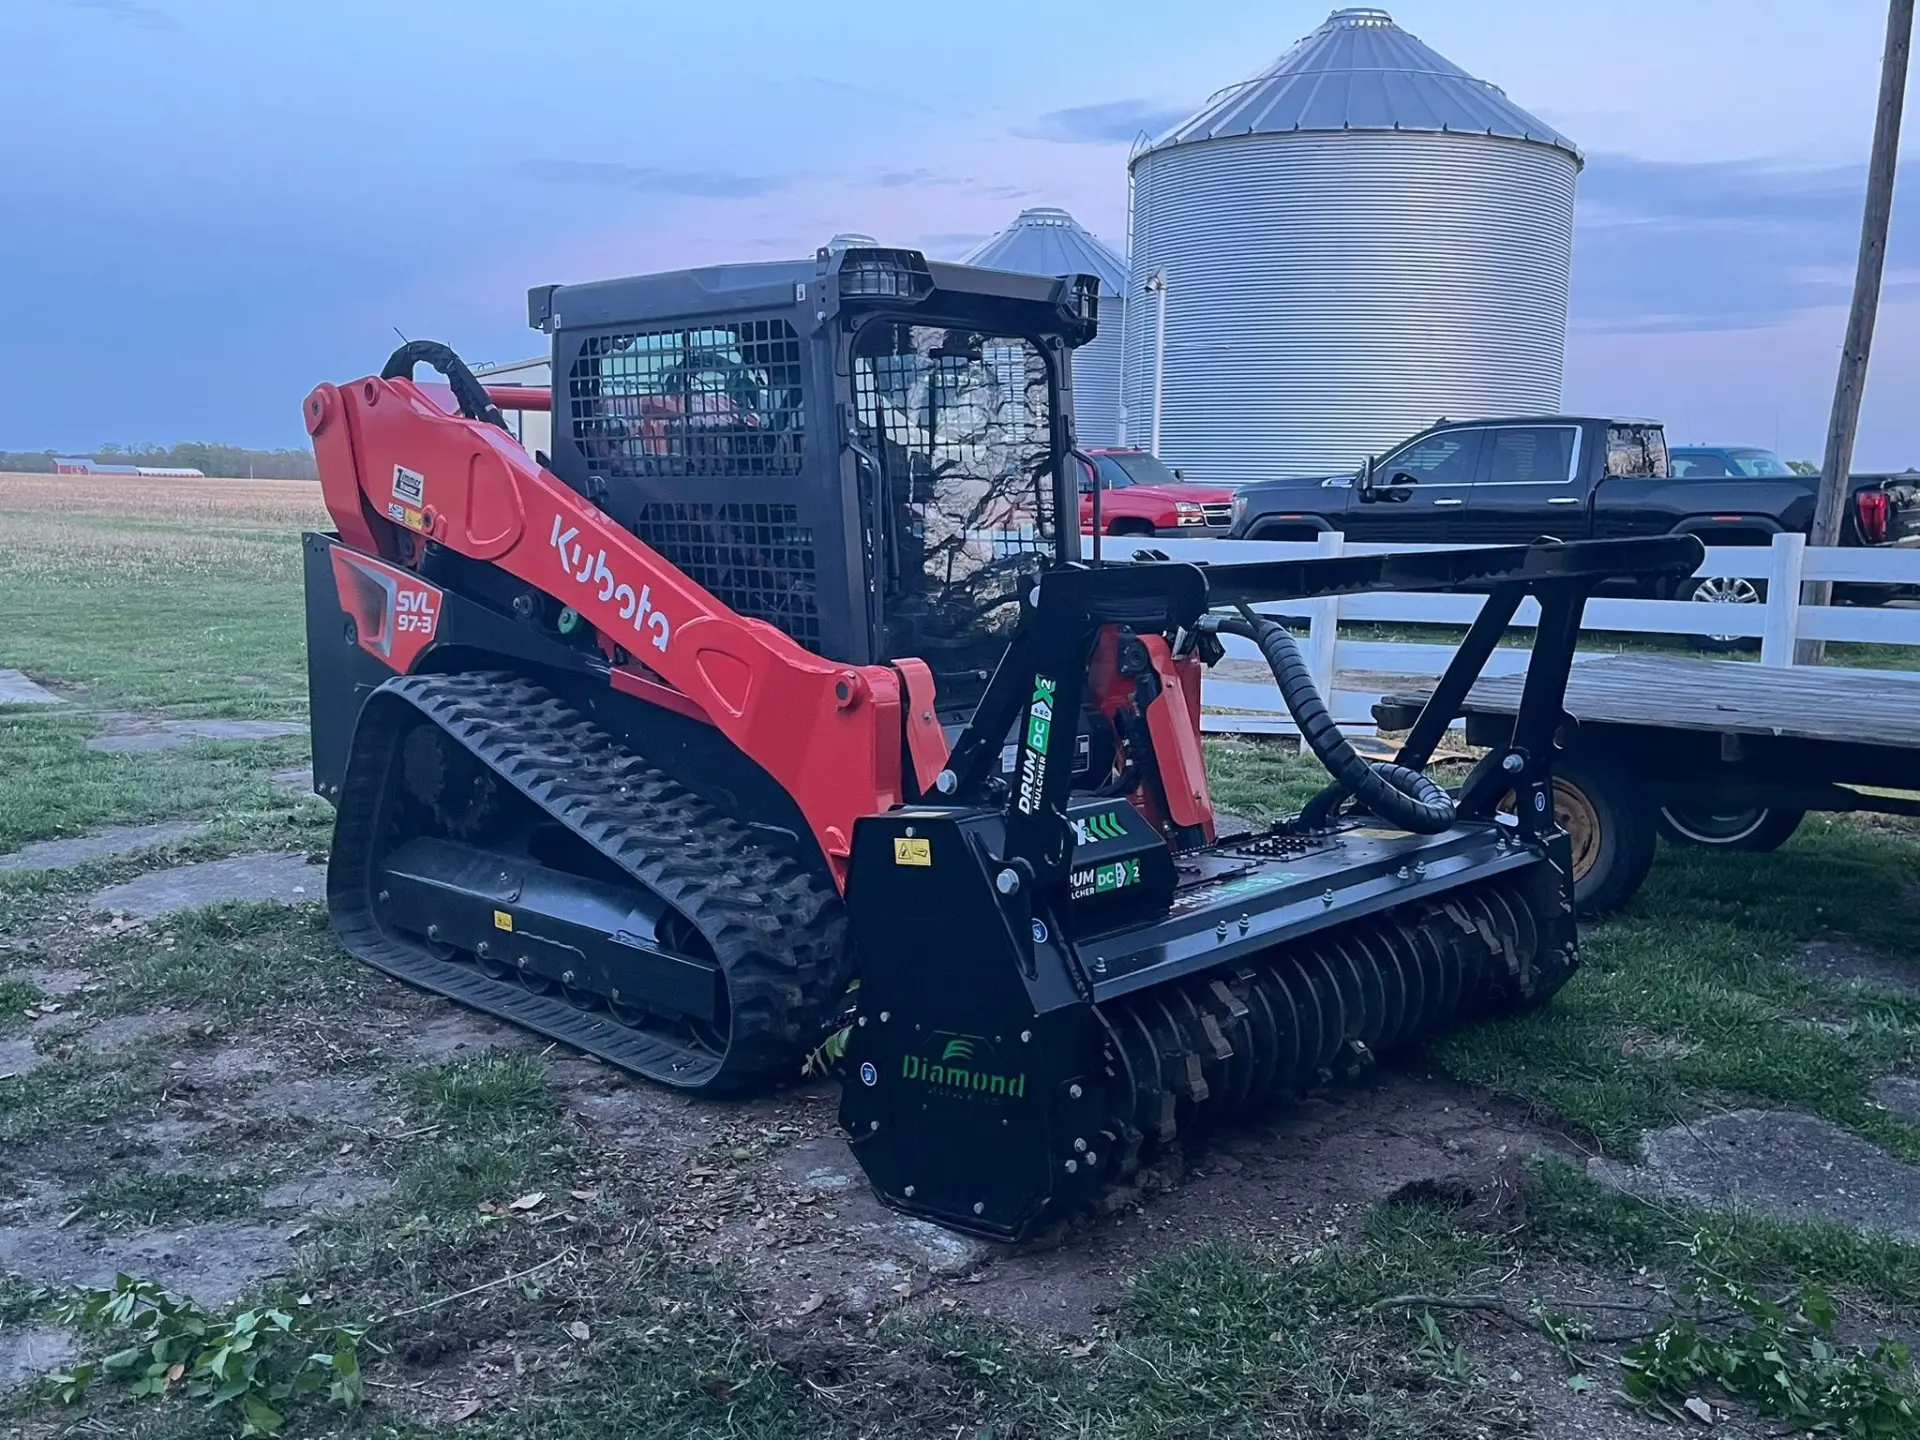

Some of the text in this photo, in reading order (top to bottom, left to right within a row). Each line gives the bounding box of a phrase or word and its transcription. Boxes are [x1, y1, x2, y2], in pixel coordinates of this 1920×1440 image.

[550, 514, 670, 653] Kubota
[396, 590, 434, 614] SVL
[397, 614, 432, 633] 97-3
[1018, 748, 1037, 816] DRUM
[1032, 721, 1045, 749] DC
[1033, 755, 1047, 811] MULCHER
[1070, 868, 1095, 888] UM
[1097, 871, 1115, 887] DC
[1071, 887, 1095, 900] LCHER
[902, 1054, 1026, 1099] Diamond
